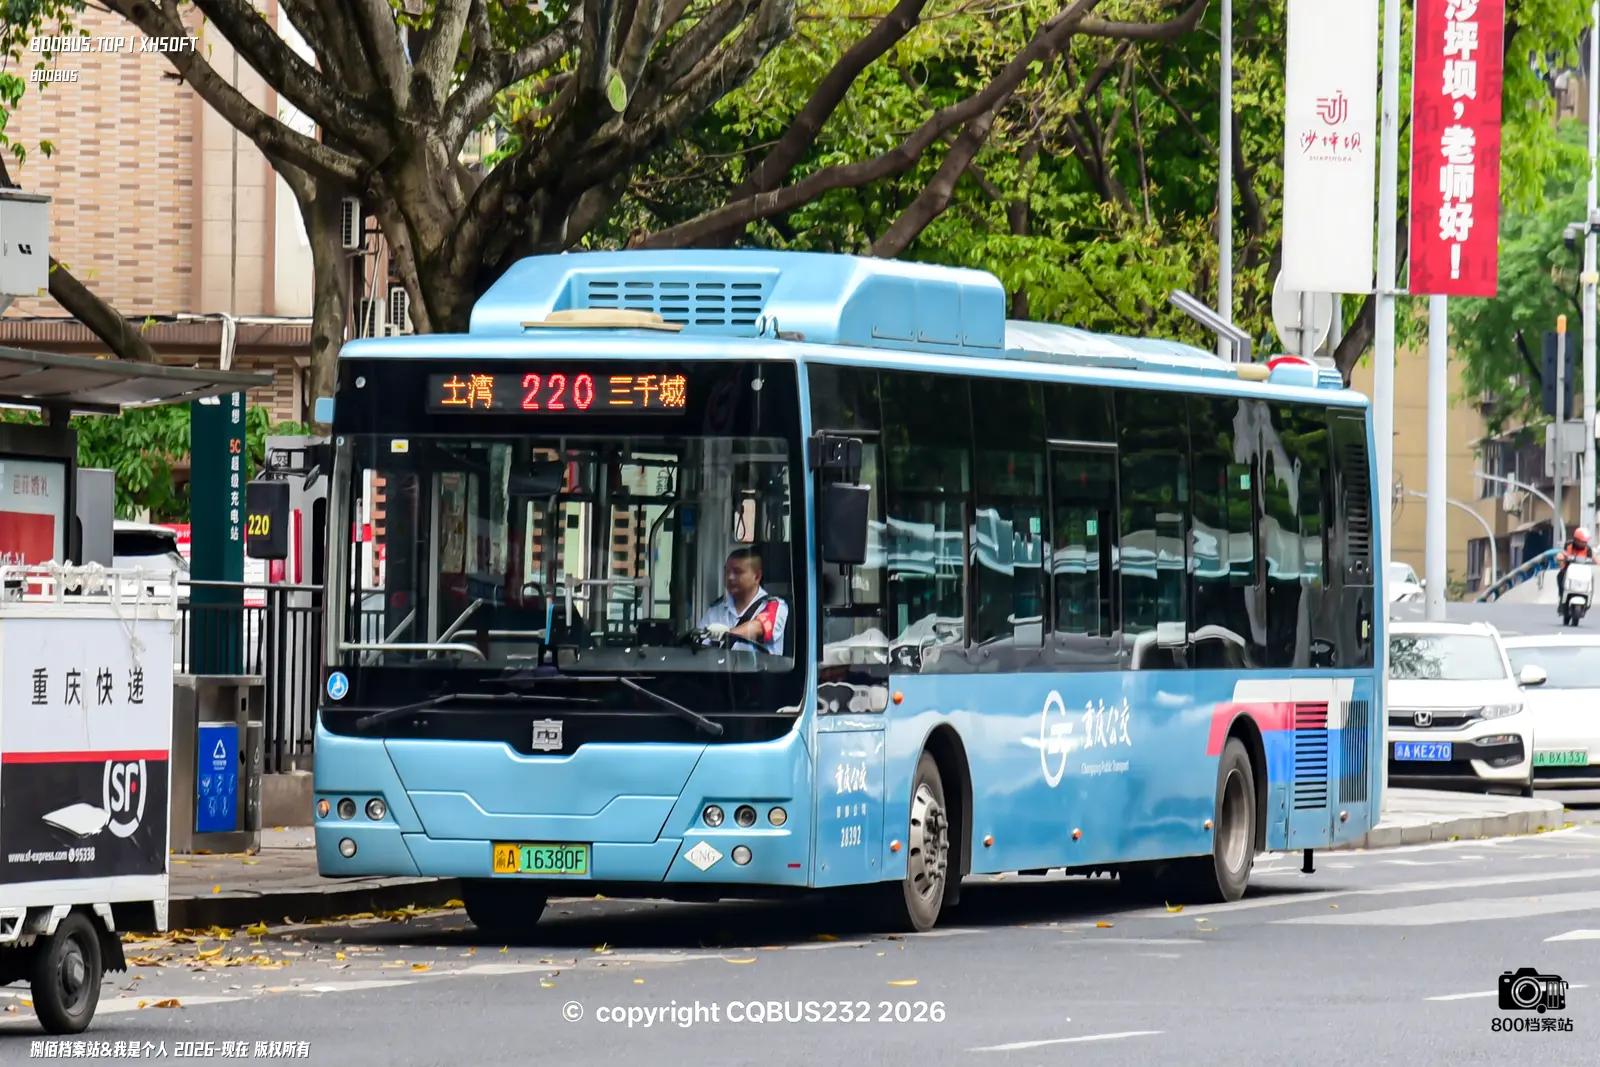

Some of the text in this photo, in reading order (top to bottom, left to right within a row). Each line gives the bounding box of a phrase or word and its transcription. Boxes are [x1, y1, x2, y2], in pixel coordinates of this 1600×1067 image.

[1300, 129, 1362, 154] 沙坪坝
[441, 373, 686, 410] 土湾 220 三千城
[248, 514, 270, 535] 220
[31, 667, 144, 706] 重庆快递
[1081, 696, 1131, 749] 重庆公交
[75, 846, 95, 862] 95338
[526, 849, 585, 870] 16380F
[690, 850, 716, 862] CNG
